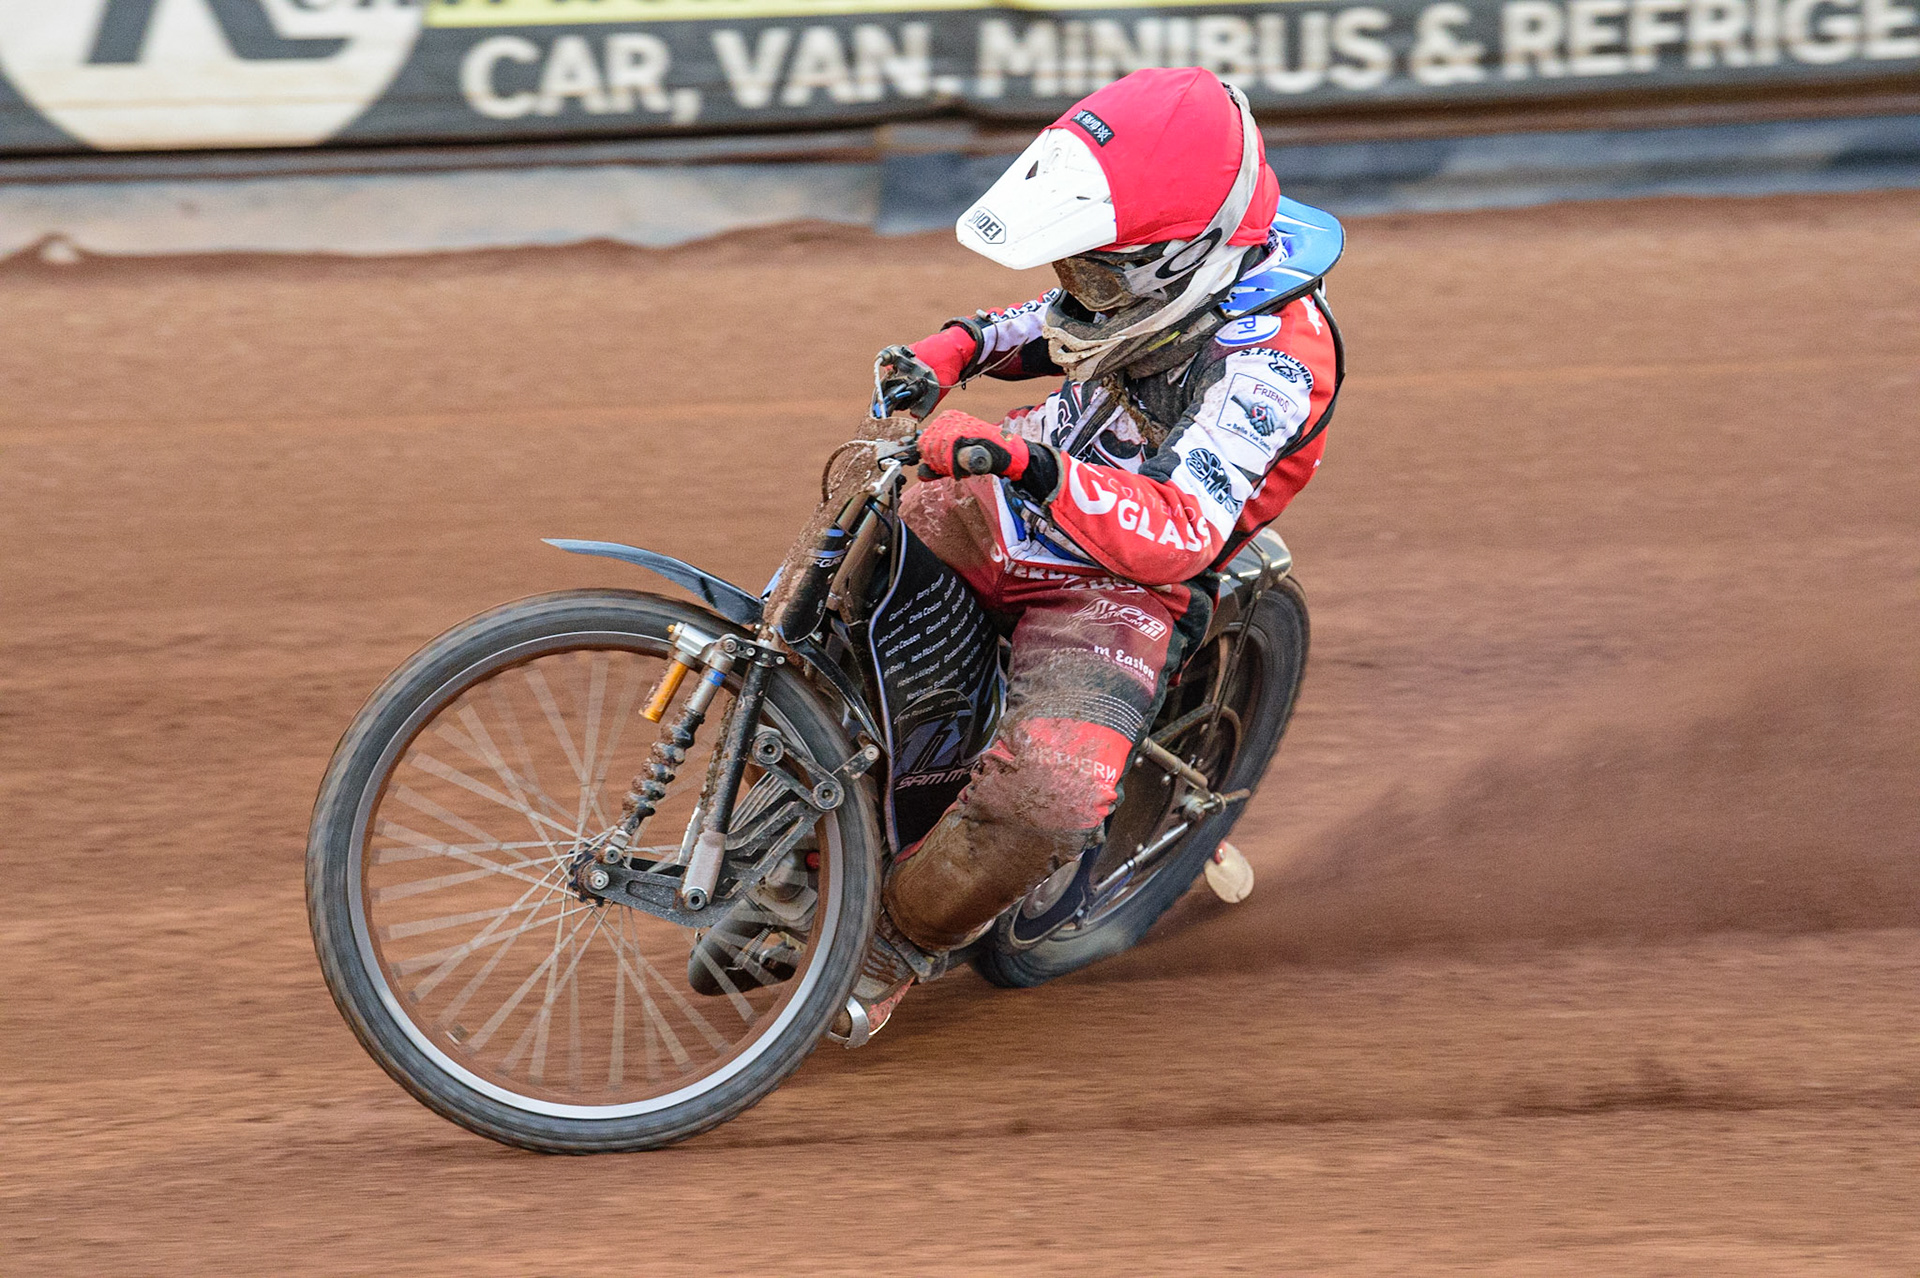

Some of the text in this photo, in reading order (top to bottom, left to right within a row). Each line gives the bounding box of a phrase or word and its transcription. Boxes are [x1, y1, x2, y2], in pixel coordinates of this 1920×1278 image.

[459, 32, 700, 125] CAR,
[979, 6, 1392, 98] MINIBUS
[1412, 2, 1484, 86] &
[1502, 0, 1920, 80] REFRIGE
[1118, 499, 1212, 552] GLASS
[1114, 649, 1156, 681] Easton
[897, 773, 946, 791] SAM
